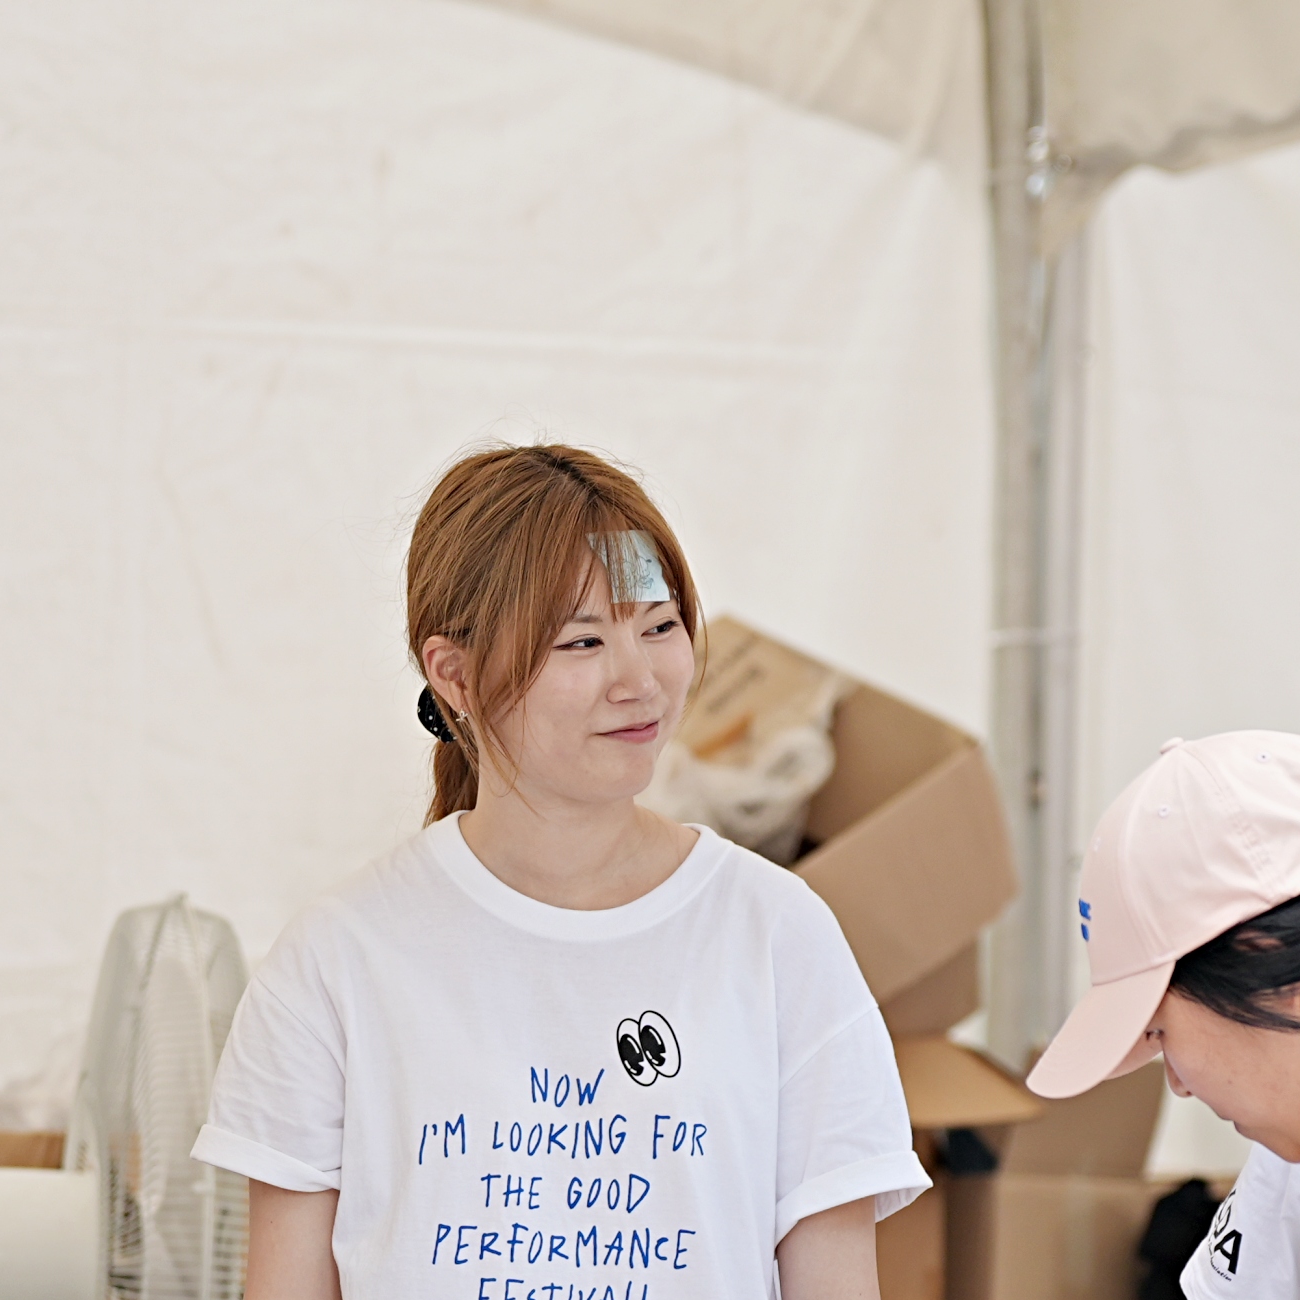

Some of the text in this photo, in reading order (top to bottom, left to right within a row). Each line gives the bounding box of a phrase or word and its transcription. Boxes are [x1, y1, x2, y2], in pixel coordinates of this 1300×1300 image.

[530, 1066, 605, 1108] NOW
[419, 1113, 708, 1165] I'M LOOKING FOR
[480, 1173, 651, 1214] THE GOOD
[431, 1222, 696, 1270] PERFORMANCE
